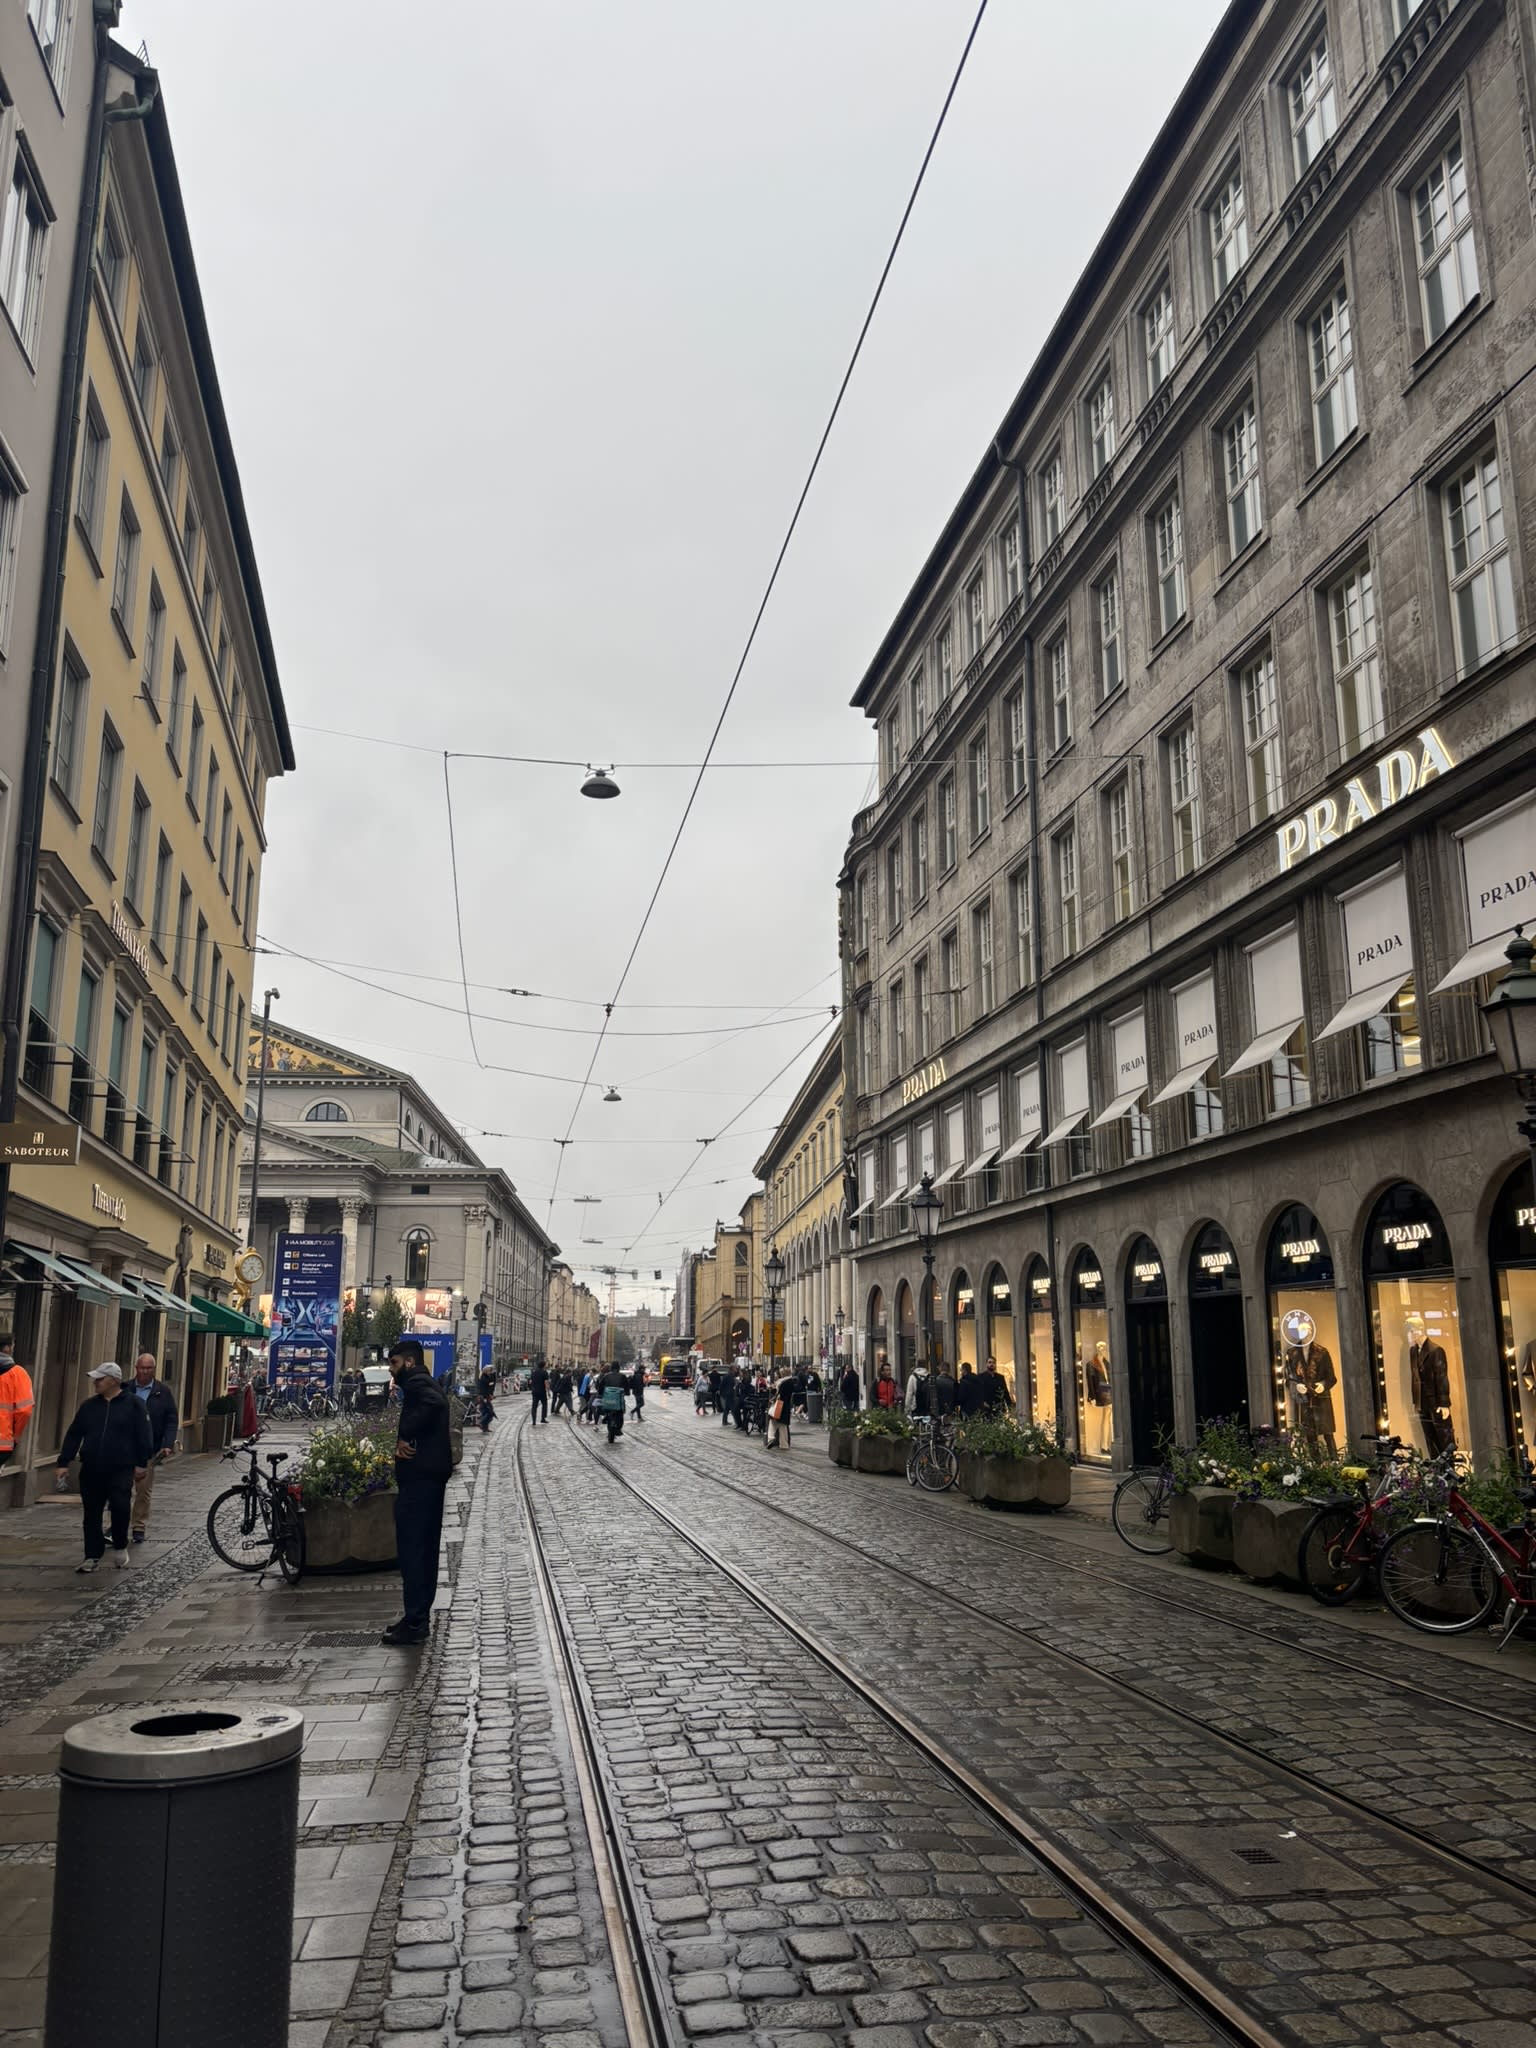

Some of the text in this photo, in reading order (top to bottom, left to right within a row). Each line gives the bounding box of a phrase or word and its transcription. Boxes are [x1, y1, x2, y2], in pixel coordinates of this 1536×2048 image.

[1276, 727, 1455, 873] PRADA
[1357, 935, 1403, 966] PRADA
[1184, 1024, 1214, 1046] PRADA
[1121, 1056, 1145, 1074] PRADA
[903, 1058, 946, 1106] PRADA
[4, 1146, 69, 1157] SABOTEUR
[1383, 1223, 1431, 1244] PRADA
[1282, 1239, 1320, 1257] PRADA
[1135, 1262, 1160, 1276] PRADA
[1201, 1252, 1232, 1268] PRADA
